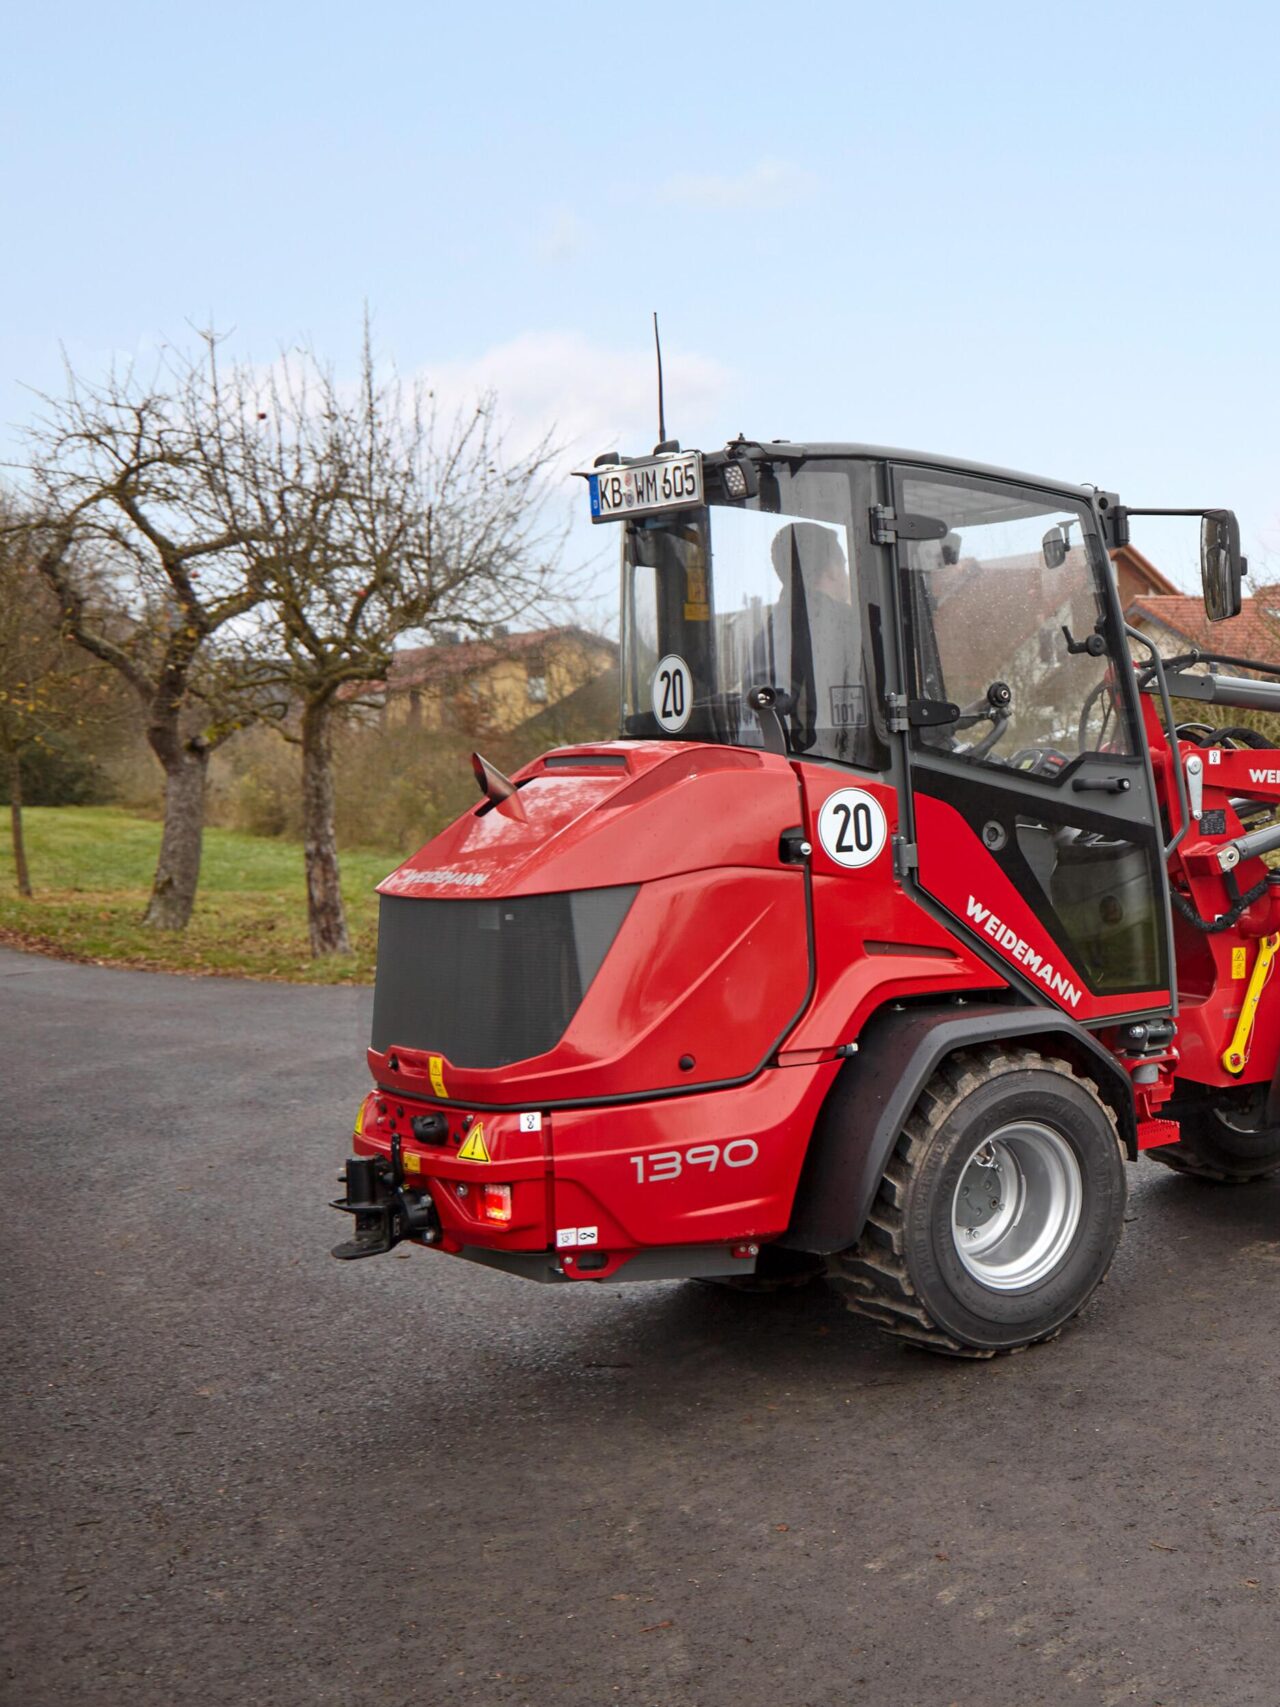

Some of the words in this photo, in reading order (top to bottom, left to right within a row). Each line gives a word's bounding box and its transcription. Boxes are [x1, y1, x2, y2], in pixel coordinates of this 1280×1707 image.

[600, 477, 623, 510] KB
[634, 469, 658, 503] WM
[663, 463, 696, 499] 605
[660, 668, 684, 719] 20
[833, 803, 873, 853] 20
[403, 870, 488, 887] WEIDEMANN
[966, 895, 1082, 1007] WEIDEMANN
[631, 1139, 759, 1183] 1390
